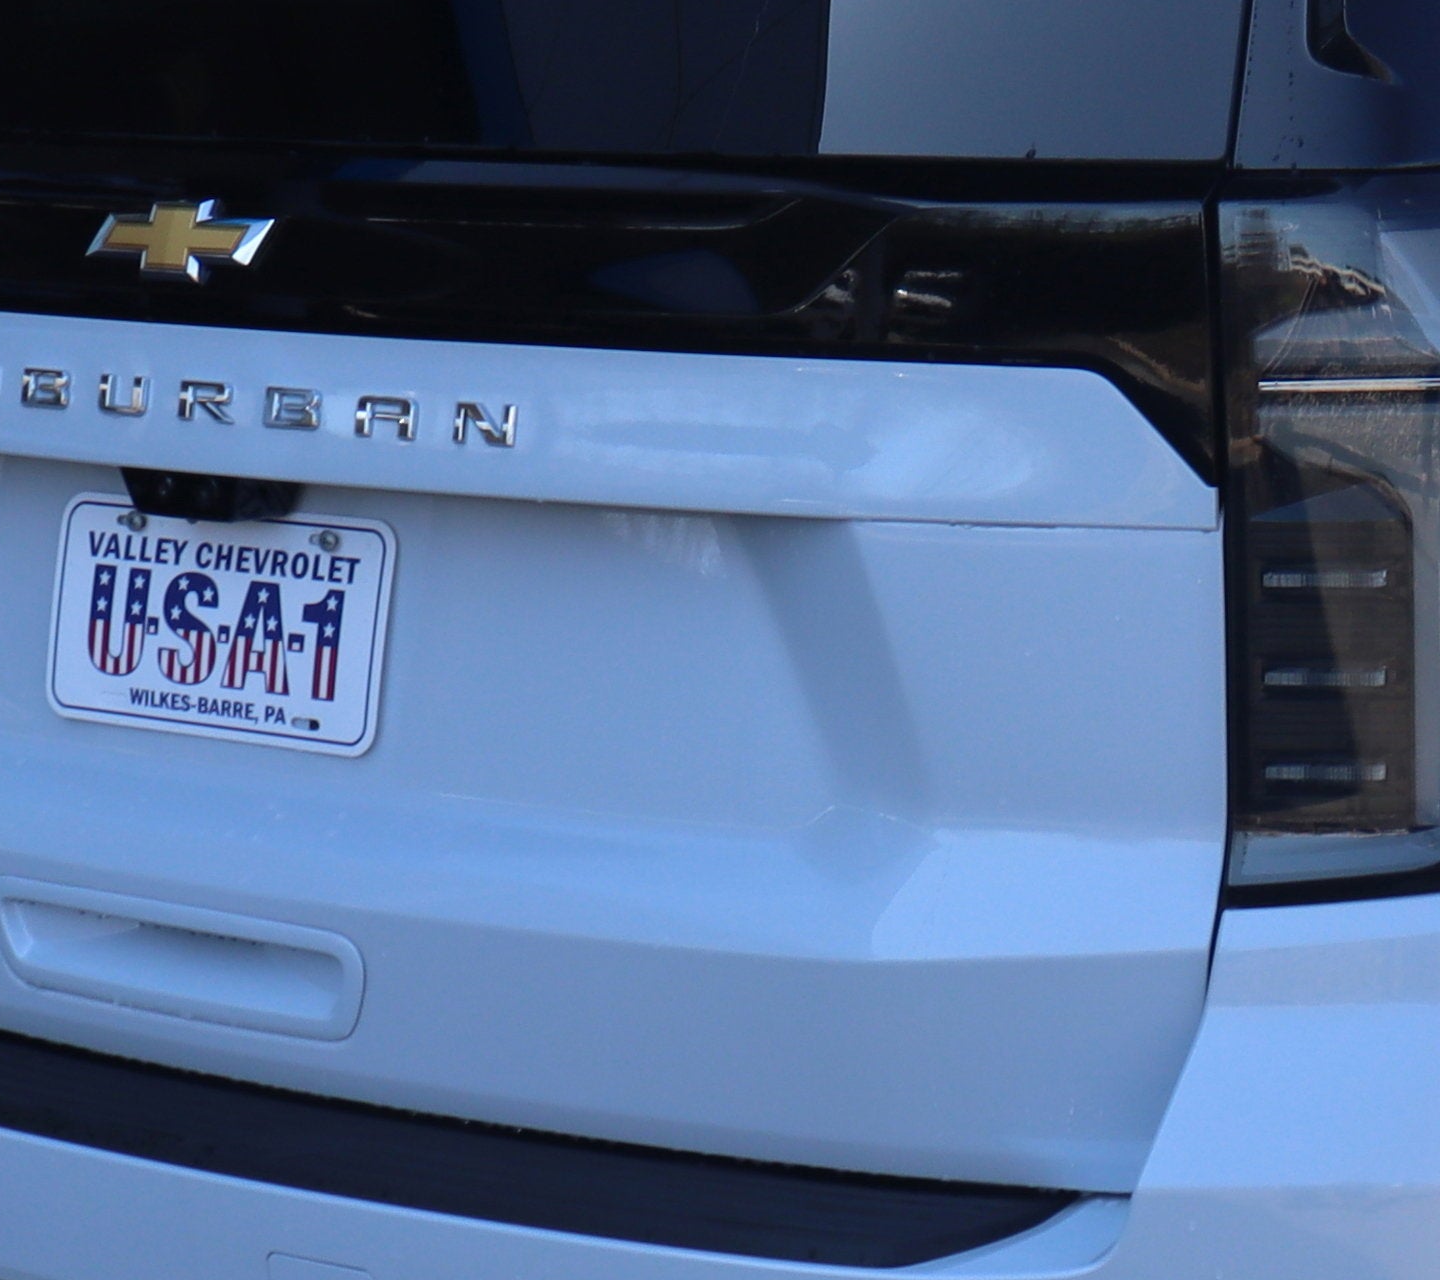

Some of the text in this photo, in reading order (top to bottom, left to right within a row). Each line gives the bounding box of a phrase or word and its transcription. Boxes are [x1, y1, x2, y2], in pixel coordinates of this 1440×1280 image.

[89, 530, 361, 585] VALLEY CHEVROLET
[129, 686, 287, 725] WILKES-BARRE, PA
